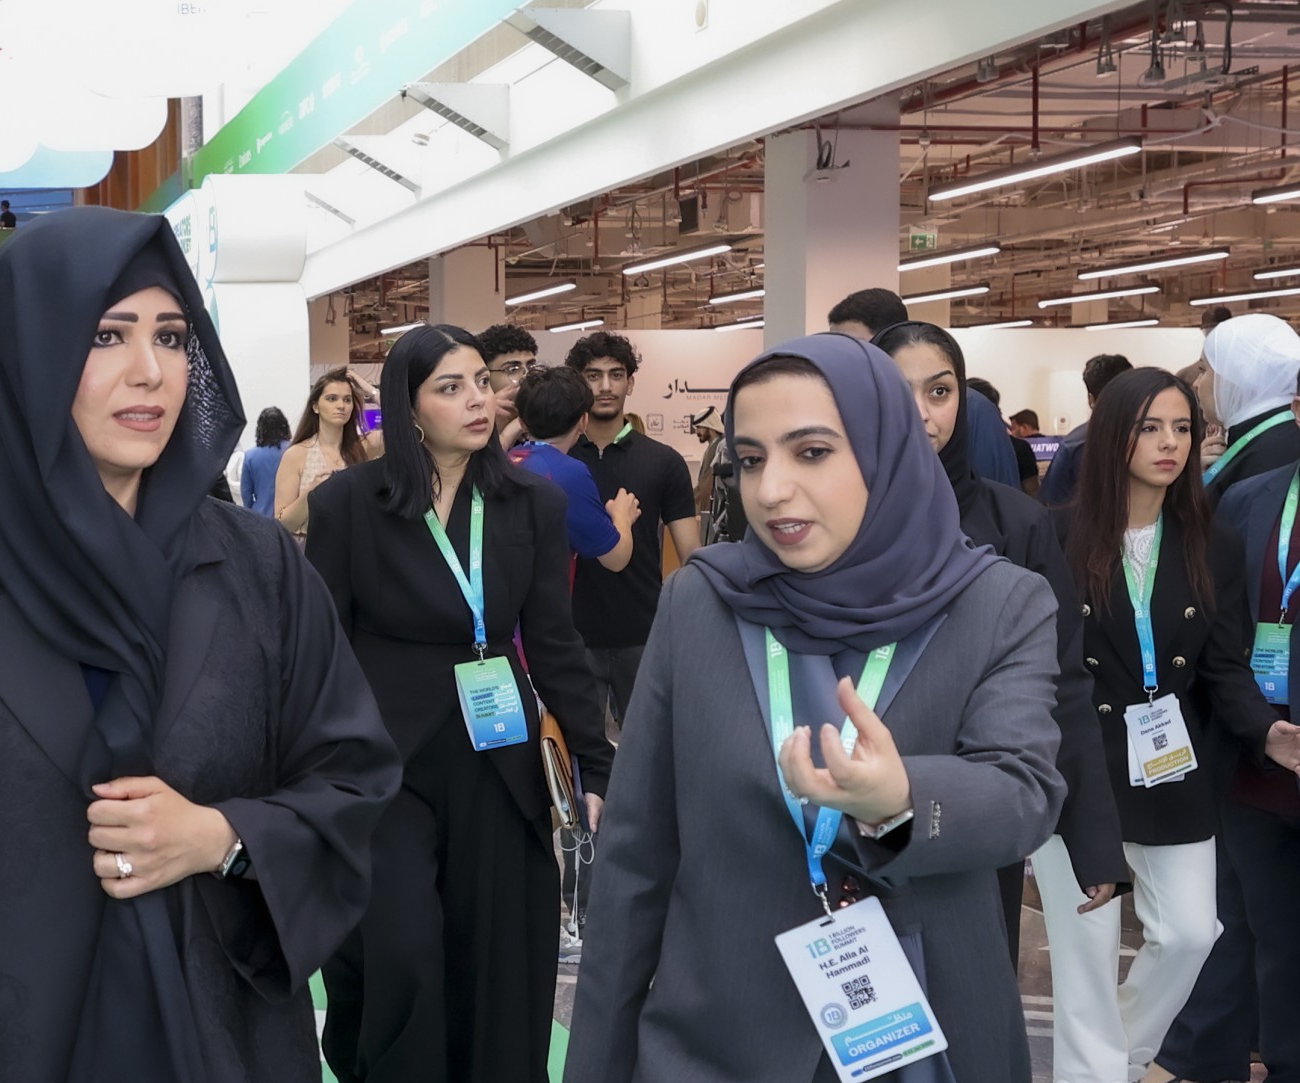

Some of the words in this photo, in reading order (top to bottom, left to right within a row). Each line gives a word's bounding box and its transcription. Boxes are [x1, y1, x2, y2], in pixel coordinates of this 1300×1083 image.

[1264, 682, 1275, 691] 1B
[493, 722, 505, 732] 1B
[1138, 714, 1150, 726] 1B
[1148, 755, 1189, 775] PRODUCTION
[831, 927, 866, 944] FOLLOWERS
[832, 926, 855, 938] BILLION
[805, 937, 831, 959] 1B
[833, 936, 857, 950] SUMMIT
[818, 958, 839, 970] H.E.
[858, 944, 869, 955] Al
[826, 955, 871, 979] Hammadi
[827, 1008, 841, 1021] 1B
[848, 1023, 921, 1058] ORGANIZER
